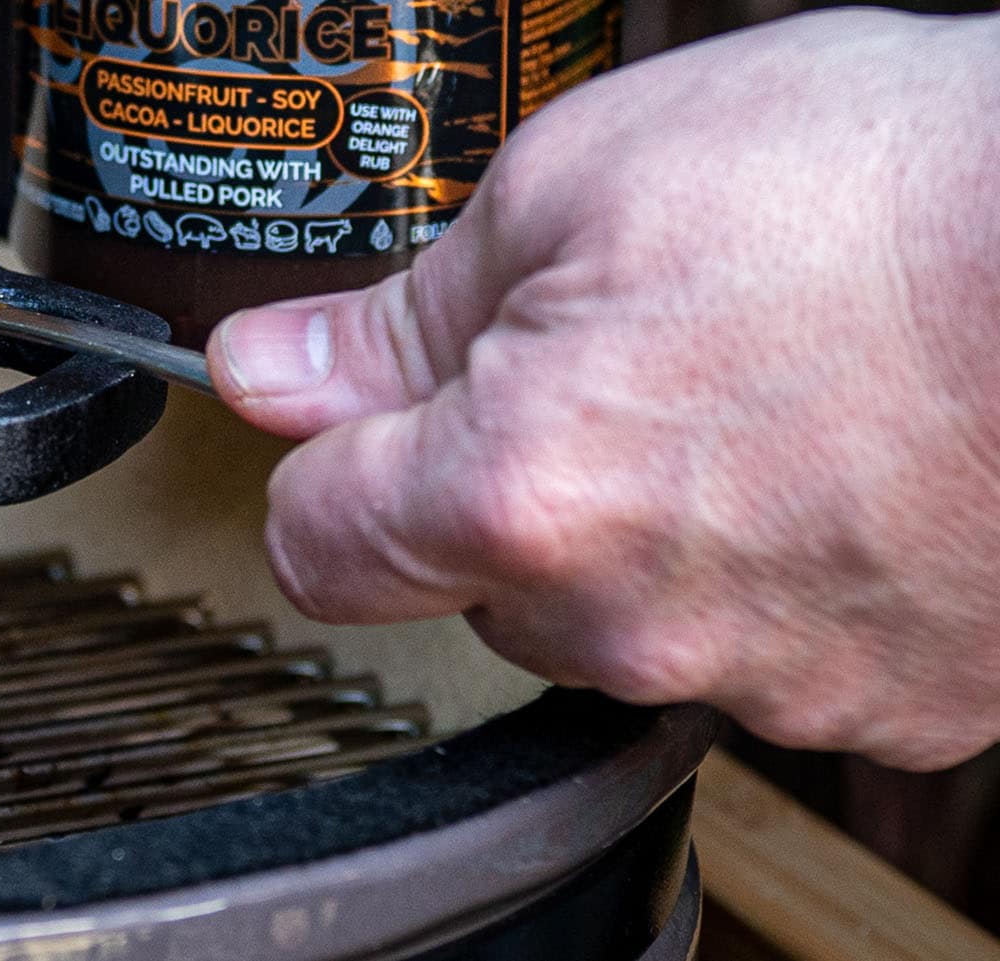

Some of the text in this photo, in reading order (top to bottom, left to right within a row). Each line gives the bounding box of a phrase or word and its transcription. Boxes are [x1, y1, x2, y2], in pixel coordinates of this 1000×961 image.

[96, 69, 253, 108] PASSIONFRUIT
[271, 89, 322, 111] SOY
[99, 98, 170, 129] CACOA
[187, 112, 316, 139] LIQUORICE
[349, 102, 417, 123] USE WITH
[350, 119, 410, 139] ORANGE
[347, 136, 408, 155] DELIGHT
[100, 140, 322, 182] OUTSTANDING WITH
[359, 154, 391, 171] RUB
[129, 175, 283, 208] PULLED PORK
